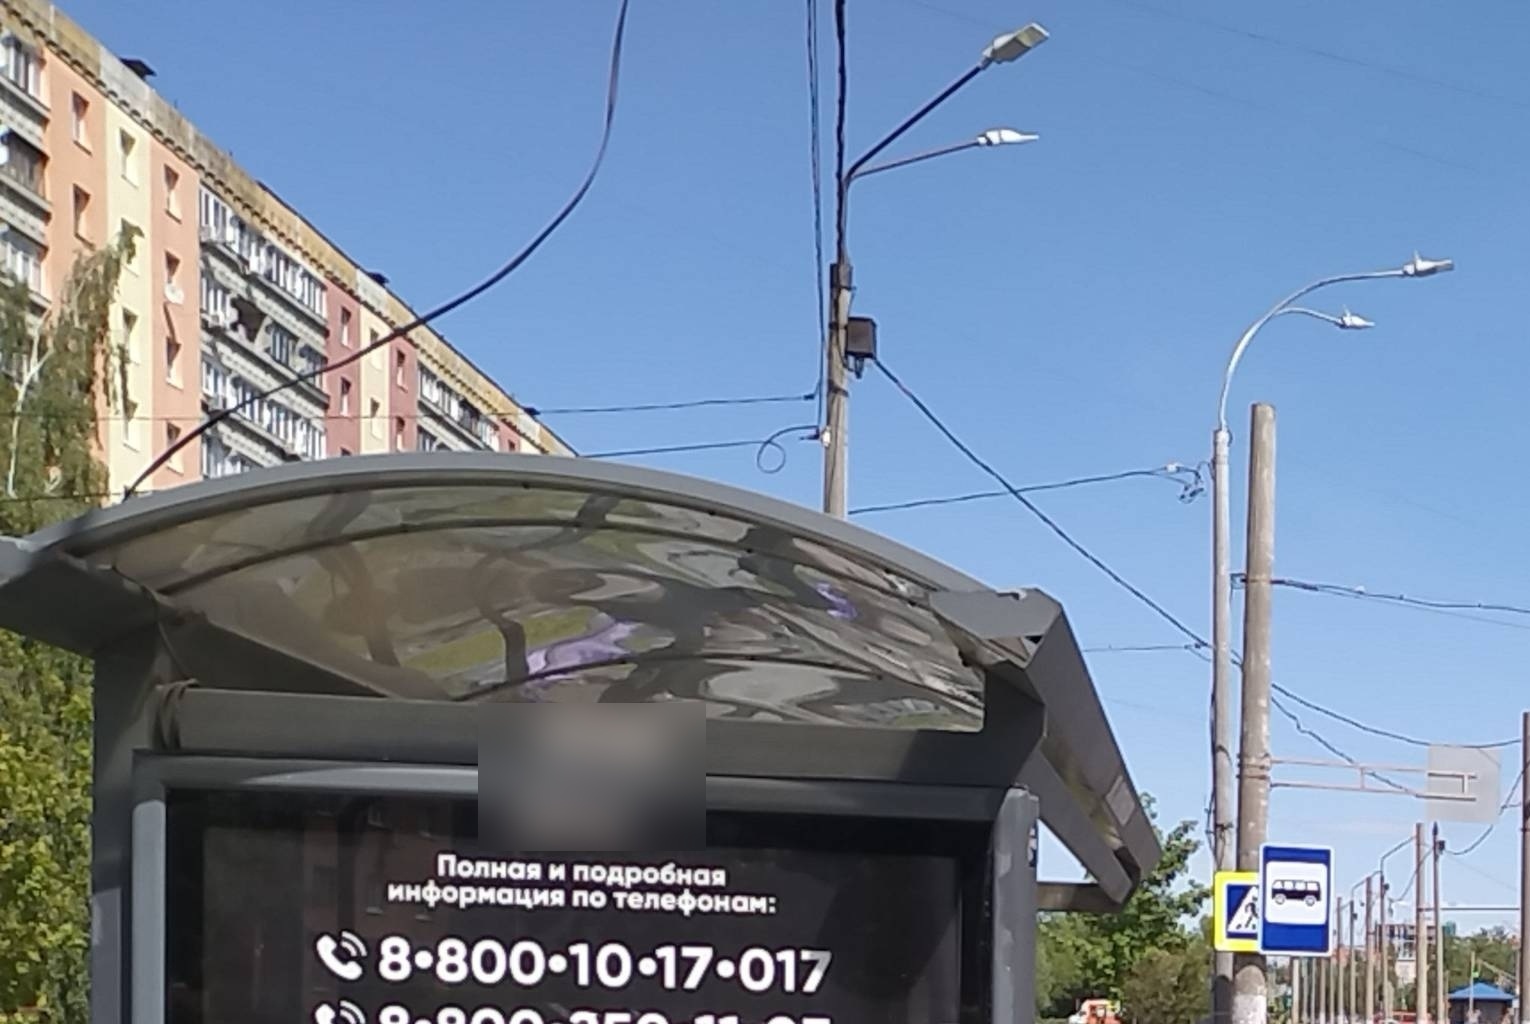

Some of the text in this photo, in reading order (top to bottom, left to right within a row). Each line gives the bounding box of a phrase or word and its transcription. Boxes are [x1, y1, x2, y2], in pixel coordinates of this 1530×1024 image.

[438, 854, 725, 888] Полная и подробная
[388, 880, 775, 916] информация по телефонам:
